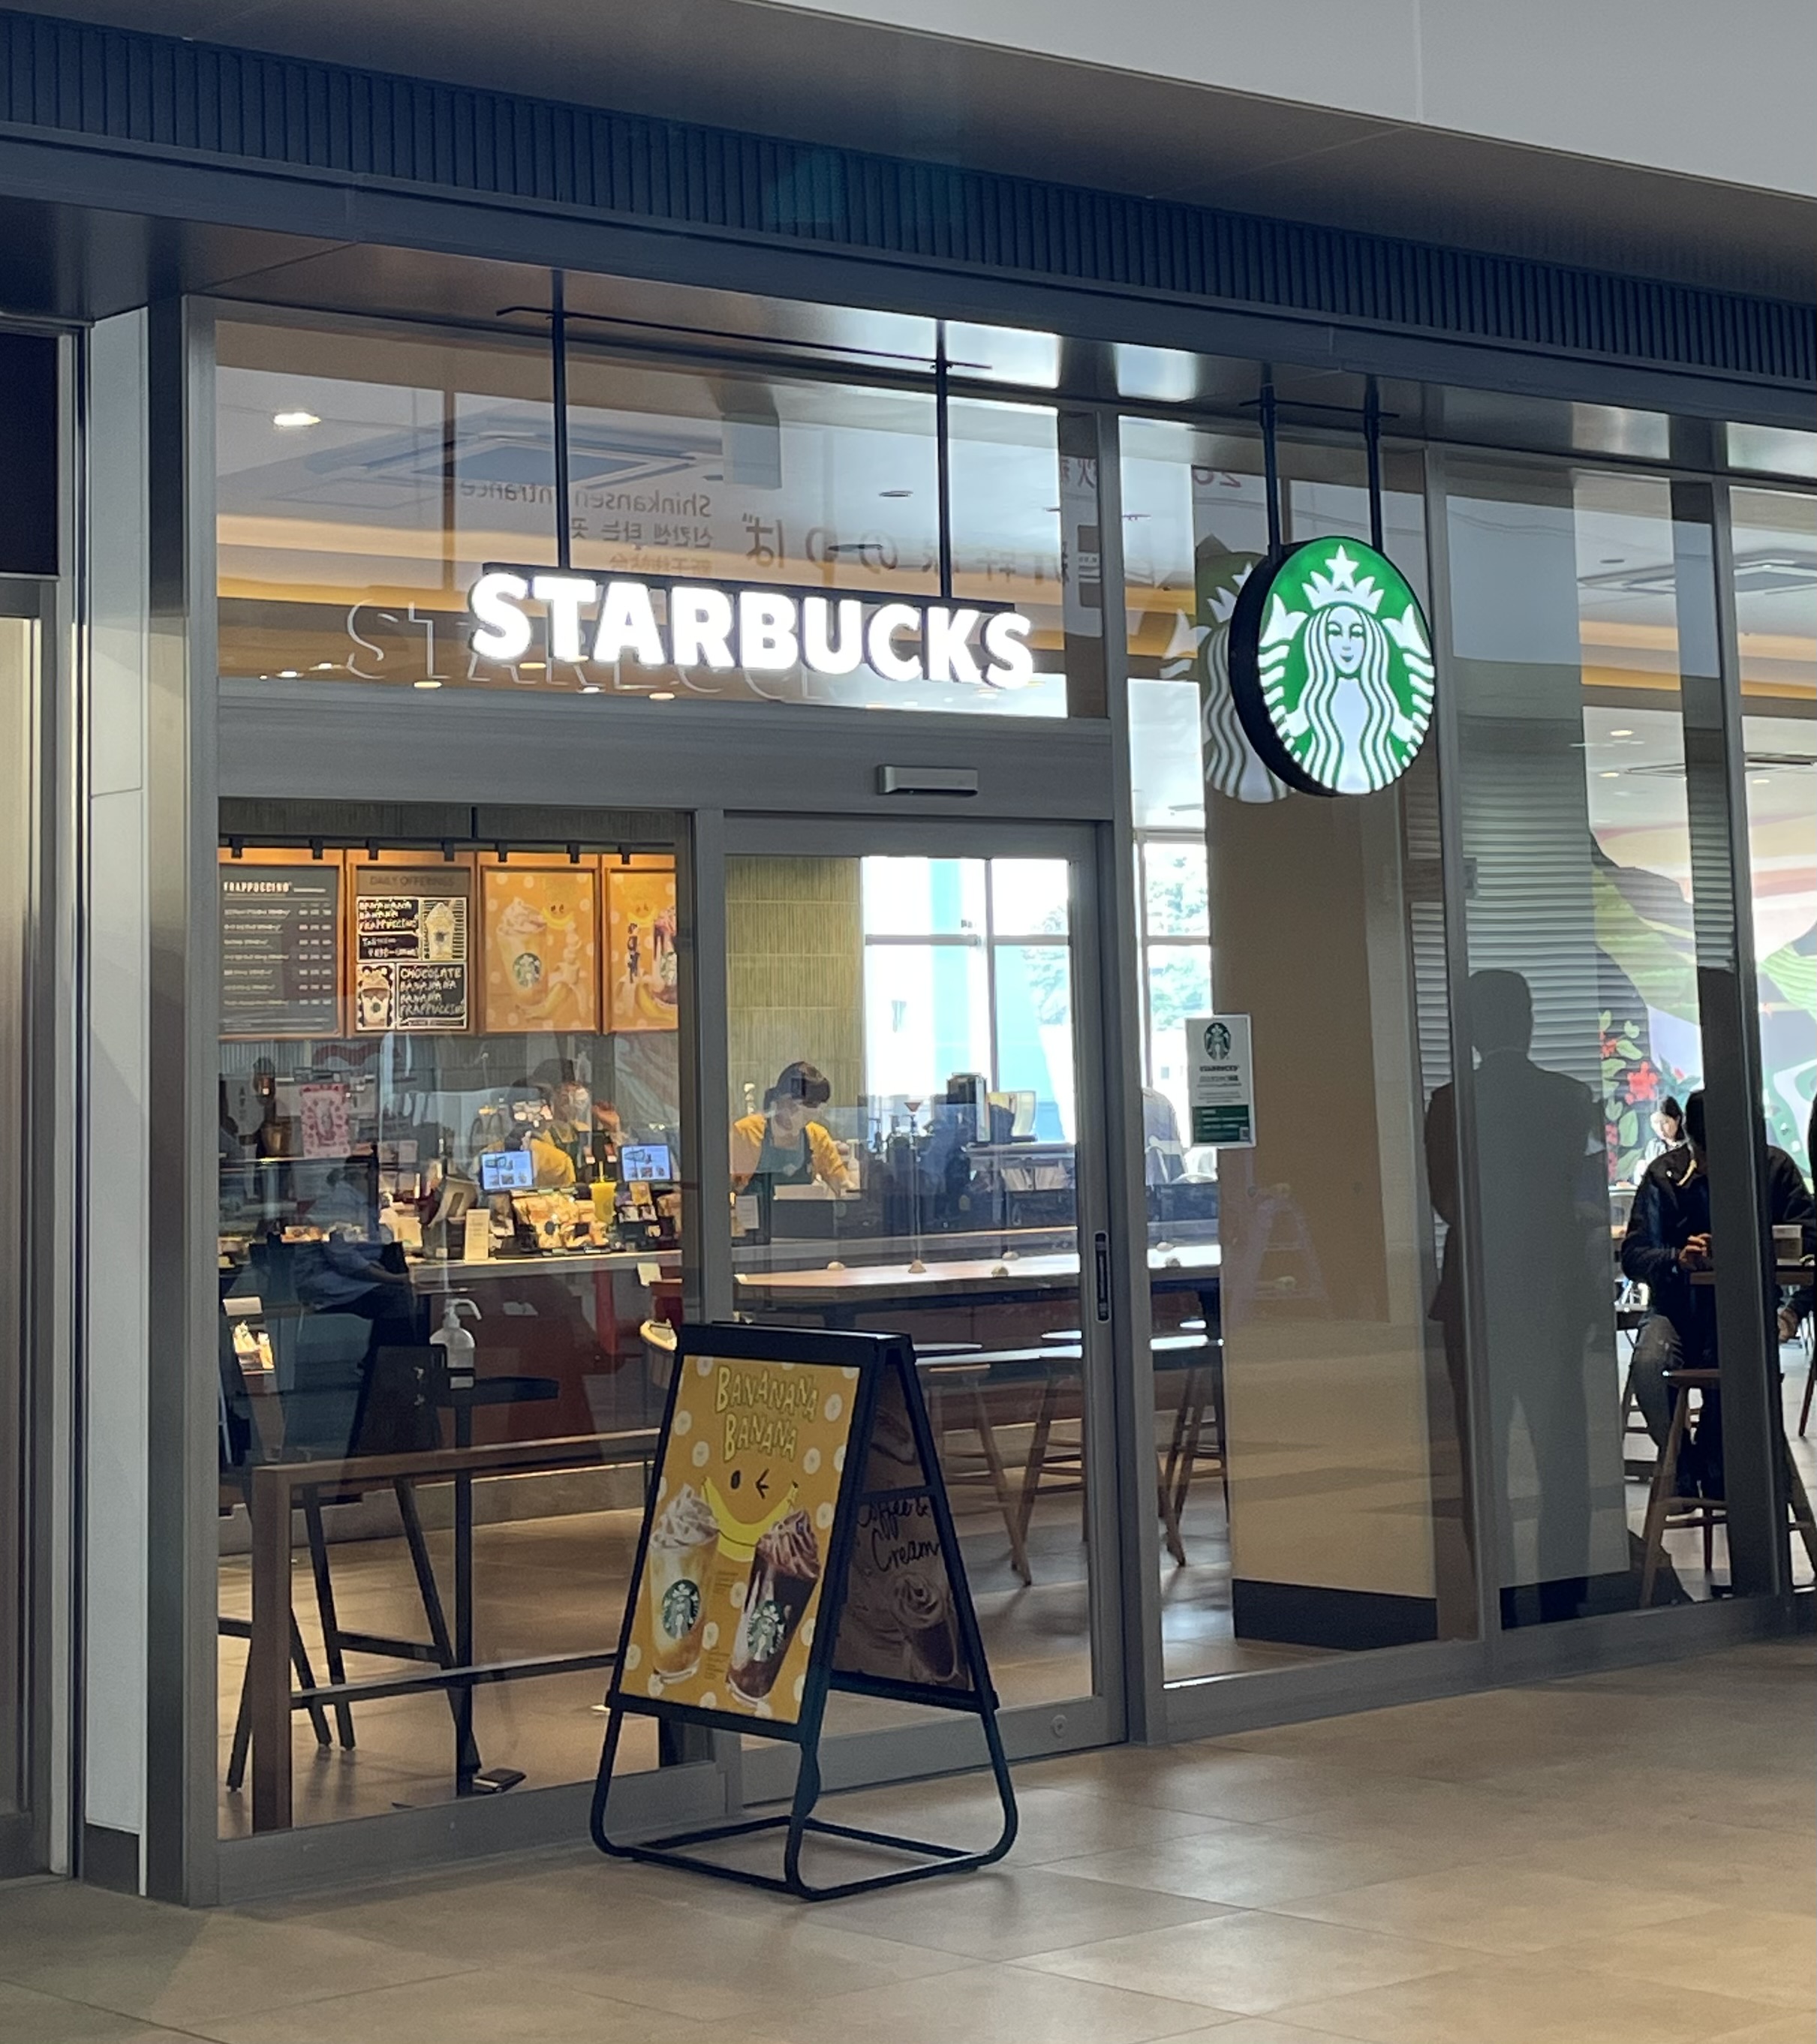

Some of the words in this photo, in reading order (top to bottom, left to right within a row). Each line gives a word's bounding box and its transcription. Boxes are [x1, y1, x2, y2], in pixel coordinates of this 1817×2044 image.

[468, 572, 1035, 690] STARBUCKS
[400, 966, 462, 978] CHOCOLATE
[723, 1412, 798, 1462] BANANA
[871, 1528, 940, 1572] Cream
